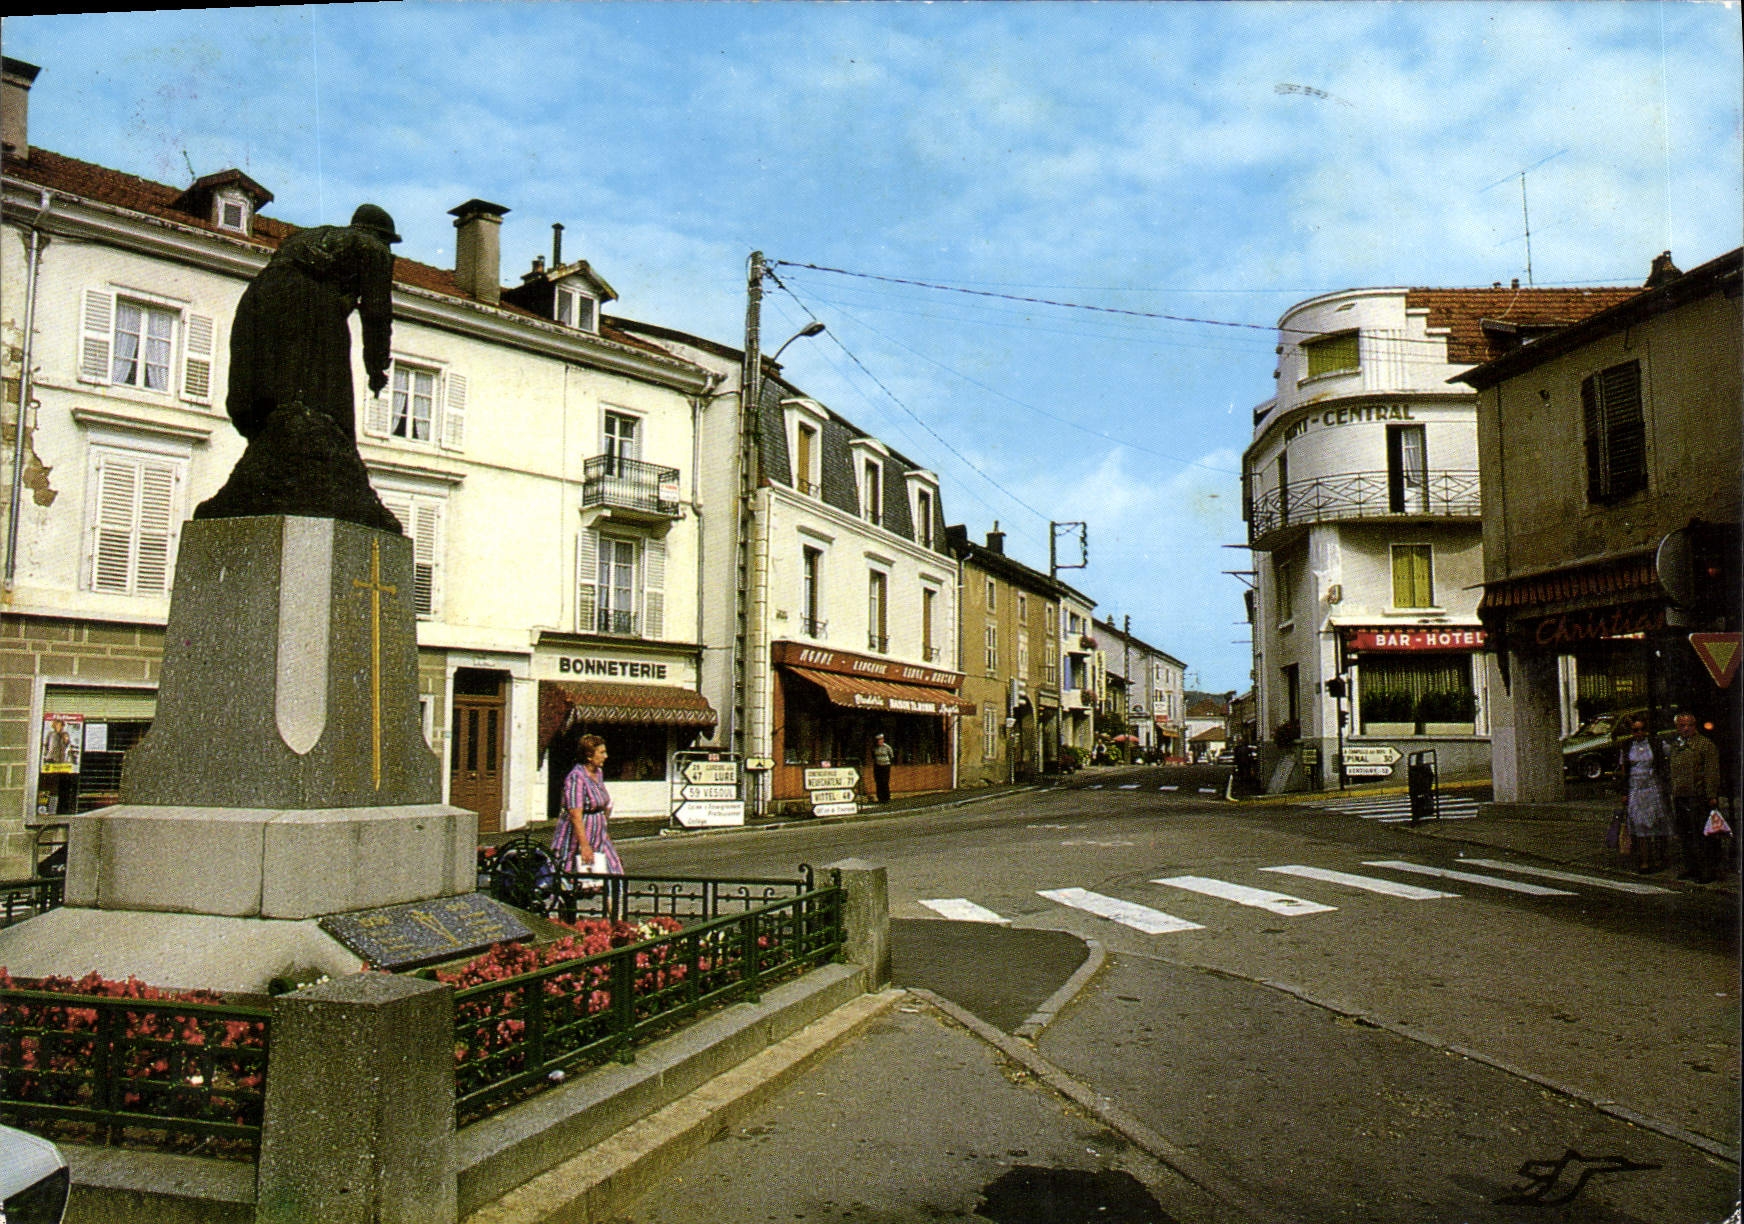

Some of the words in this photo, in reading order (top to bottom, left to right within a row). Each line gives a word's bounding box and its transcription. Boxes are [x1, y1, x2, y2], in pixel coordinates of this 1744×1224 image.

[1375, 634, 1410, 646] BAR
[1426, 632, 1484, 645] HOTEL
[559, 657, 667, 679] BONNETERIE
[714, 772, 735, 781] LURE
[689, 787, 700, 797] 59
